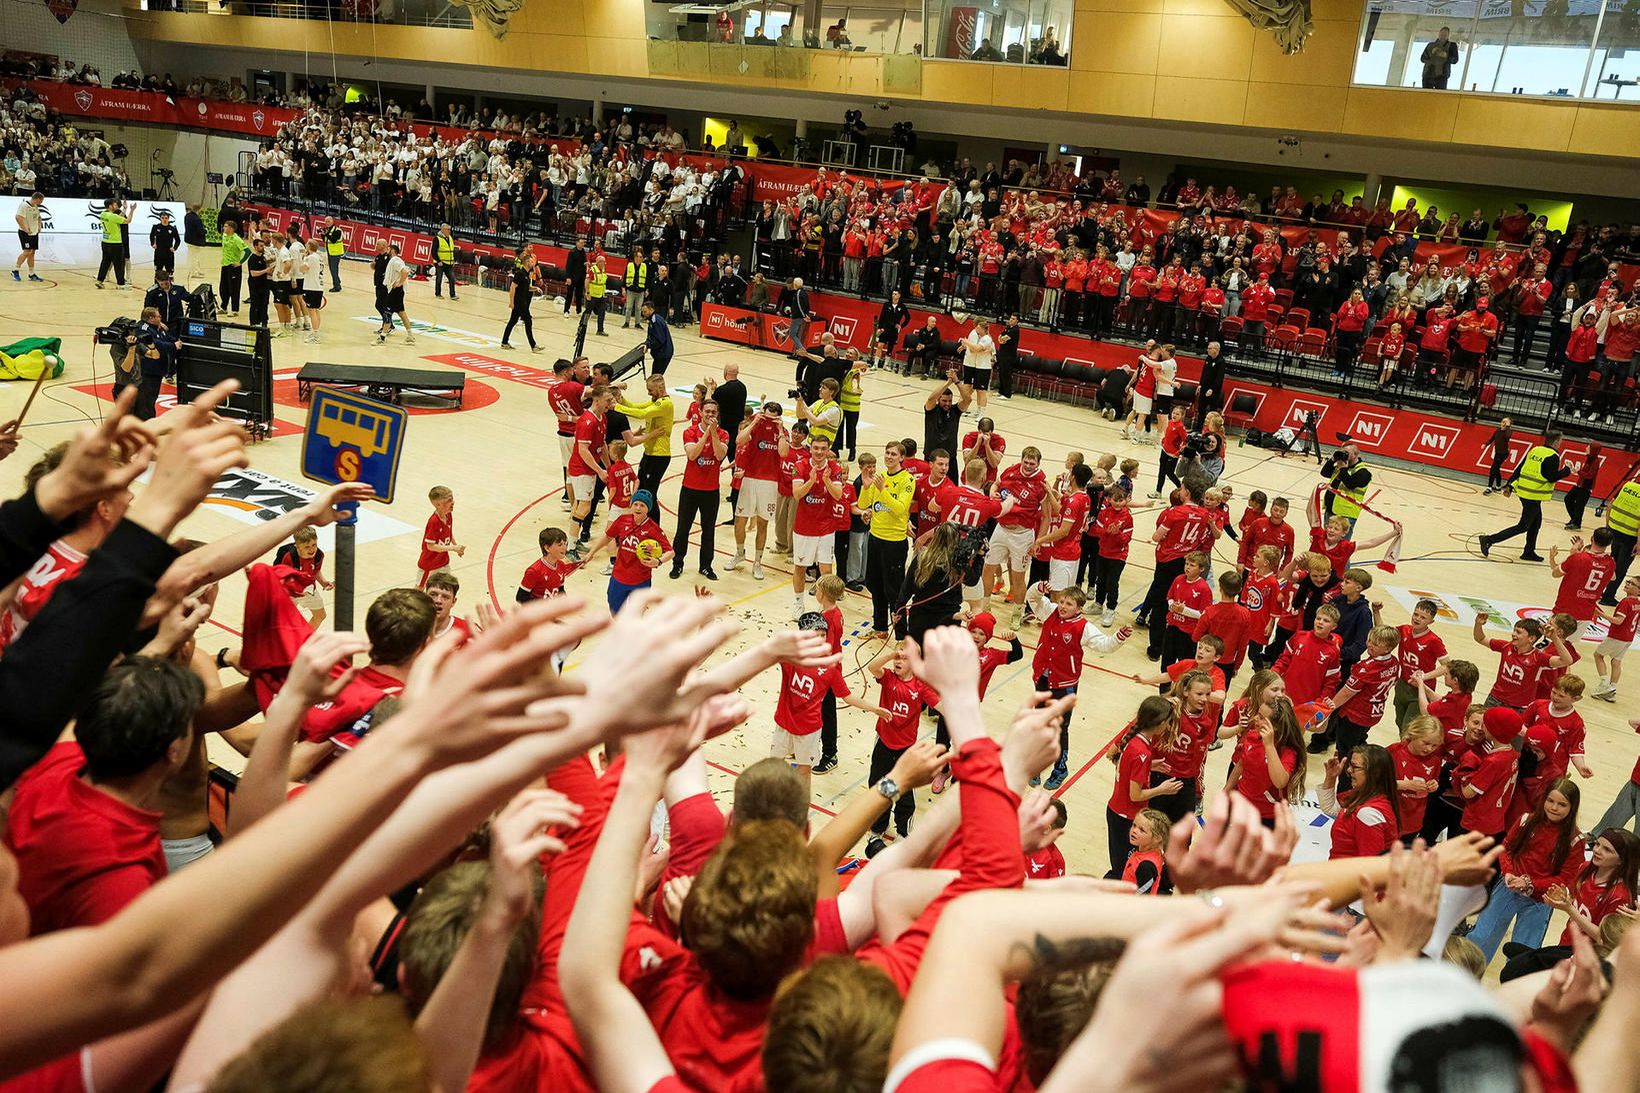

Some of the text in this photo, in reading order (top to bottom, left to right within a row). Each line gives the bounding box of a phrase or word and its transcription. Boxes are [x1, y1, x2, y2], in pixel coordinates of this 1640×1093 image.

[757, 178, 785, 191] ÁFRAM
[365, 235, 375, 246] N1
[418, 245, 428, 255] N1
[711, 316, 721, 324] N1
[833, 323, 850, 336] N1
[1356, 420, 1381, 438] N1
[1420, 432, 1447, 449] N1
[337, 450, 360, 482] S
[947, 504, 981, 528] 40
[1180, 521, 1200, 544] 14
[1584, 569, 1604, 591] 6
[791, 672, 815, 694] NA
[892, 701, 910, 715] NA
